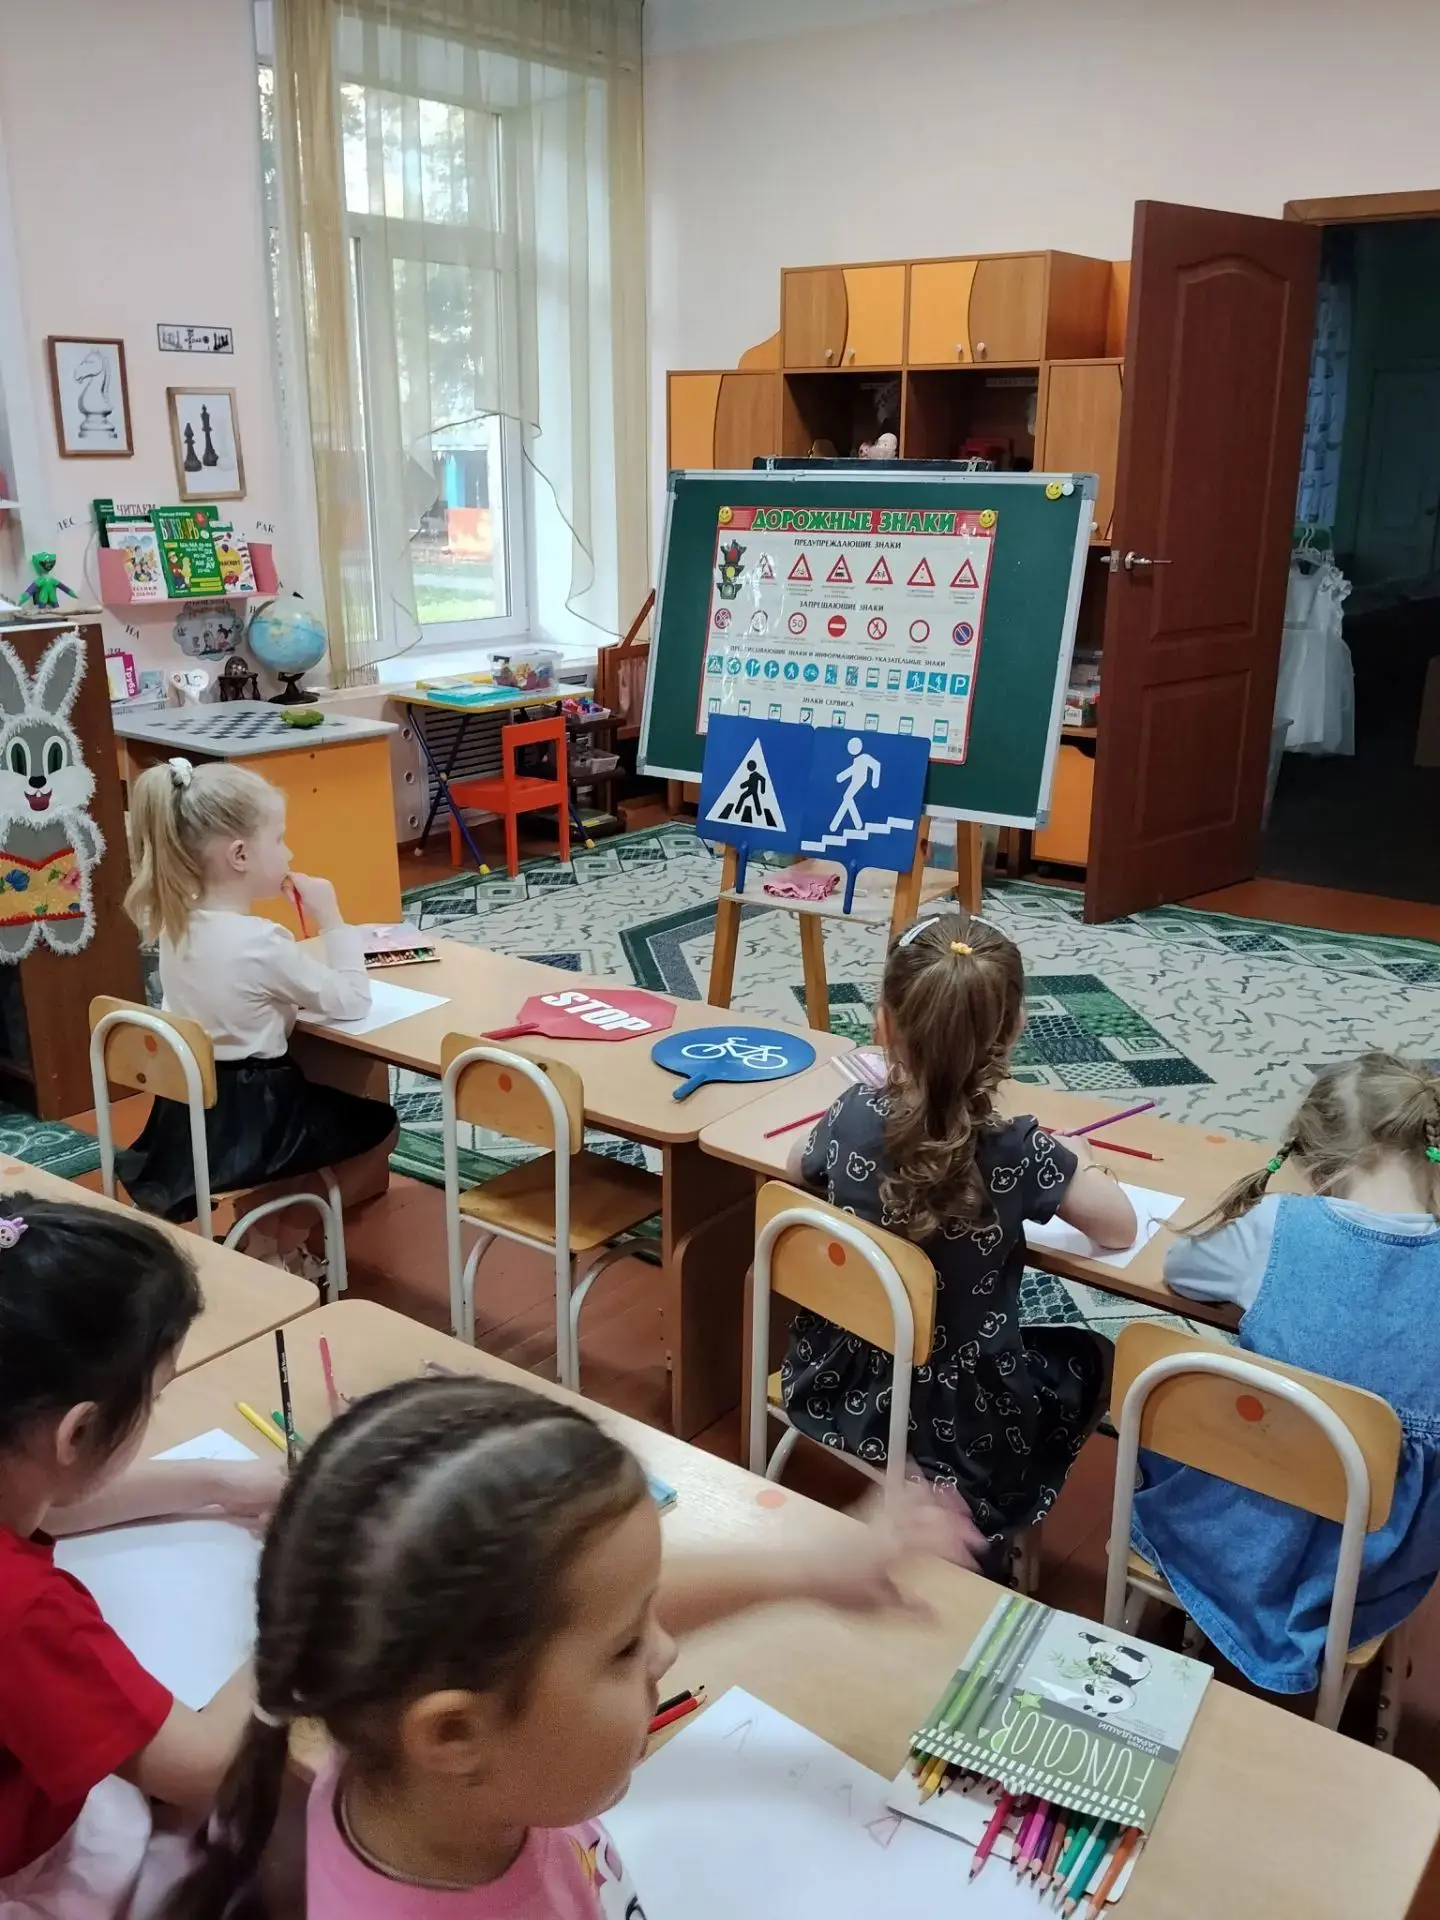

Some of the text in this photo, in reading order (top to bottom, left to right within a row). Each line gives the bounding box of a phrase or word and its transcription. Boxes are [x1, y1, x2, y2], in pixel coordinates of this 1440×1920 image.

[159, 518, 199, 540] БУКВАРЬ
[256, 521, 275, 533] РАК
[751, 510, 956, 533] ДОРОЖНЫЕ ЗНАКИ
[794, 538, 902, 550] ПРЕДУПРЕЖДАЮЩИЕ ЗНАКИ
[799, 600, 884, 612] ЗАПРЕЩАЮЩИЕ ЗНАКИ
[792, 619, 803, 628] 50
[730, 645, 787, 655] ПРЕИСЫВАЮЩИЕ
[788, 649, 807, 657] ЗНАКИ
[814, 652, 922, 665] ИНФОРМАЦИОННО-УКАЗАТЕЛЬНЫЕ
[803, 697, 855, 708] ЗНАКИ СЕРВИСА
[540, 991, 652, 1031] STOP
[1098, 1721, 1161, 1751] КАРАНДАШИ
[990, 1697, 1156, 1802] FUNCOLOR
